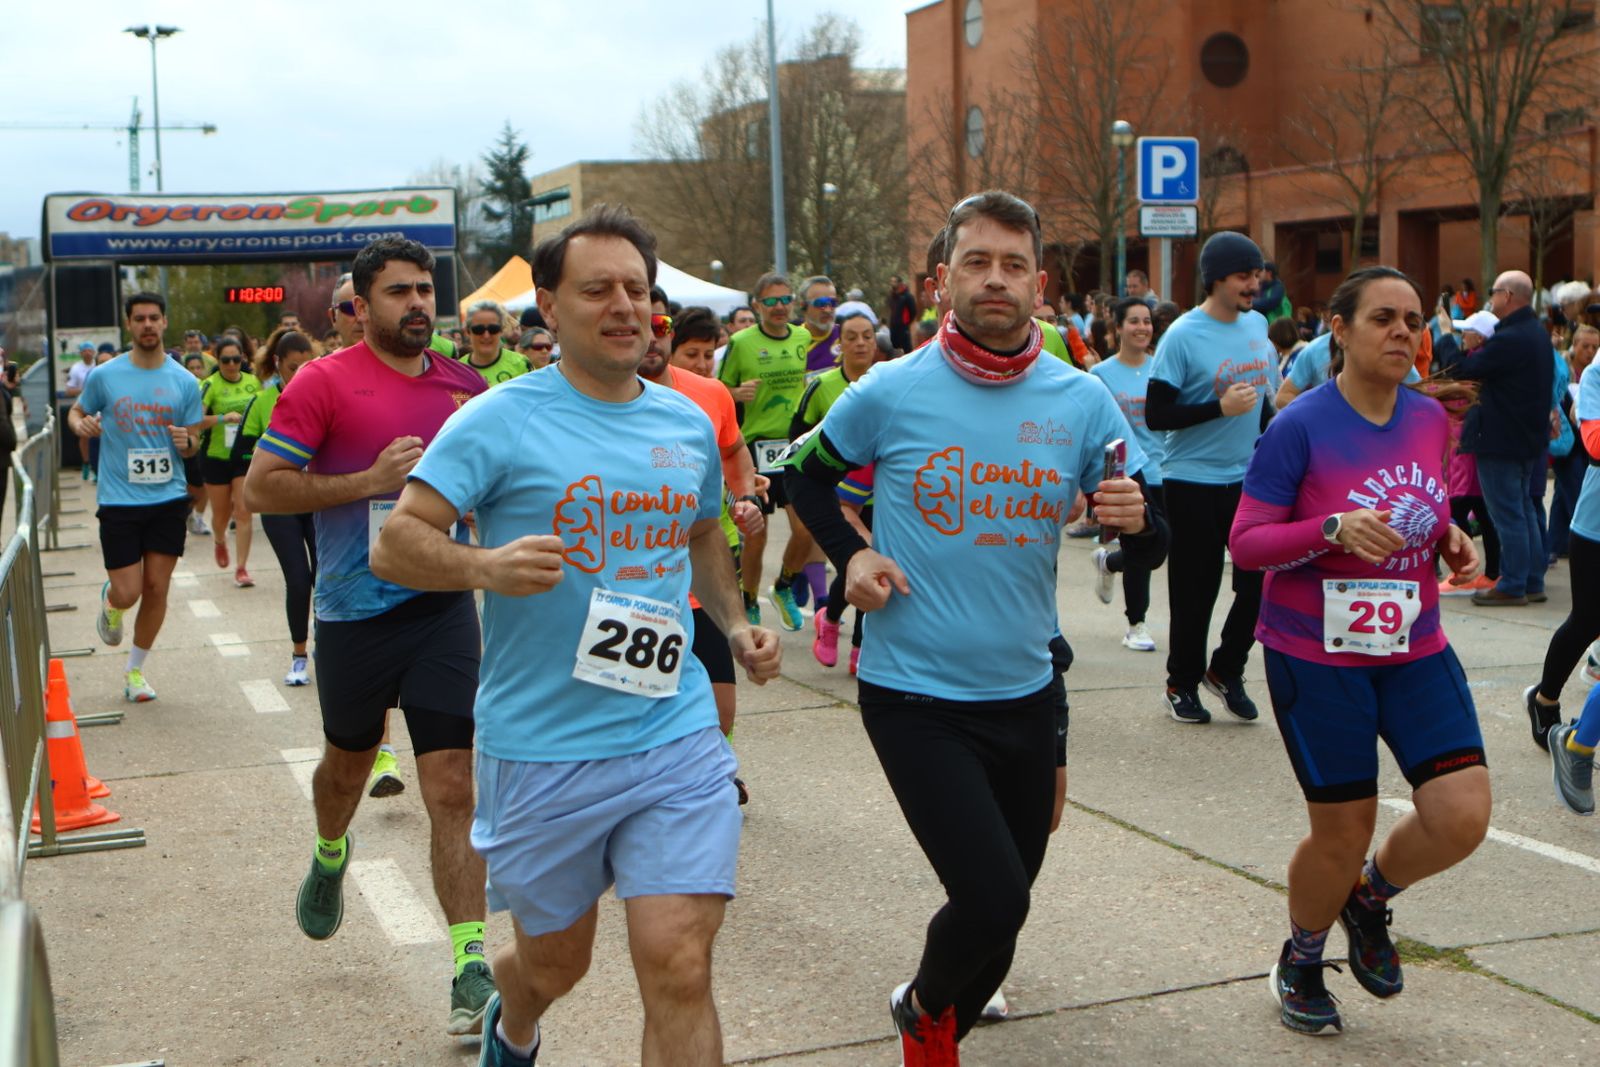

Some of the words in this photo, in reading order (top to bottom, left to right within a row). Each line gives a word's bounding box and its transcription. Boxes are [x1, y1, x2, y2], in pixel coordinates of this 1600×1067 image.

[1151, 145, 1187, 195] P
[107, 230, 404, 250] www.orycronsport.com
[229, 287, 283, 303] 11:02:00
[133, 459, 170, 473] 313
[971, 459, 1061, 487] contra
[611, 484, 697, 515] contra
[1347, 461, 1446, 510] Apaches
[970, 494, 999, 519] el
[1005, 492, 1063, 523] ictus
[610, 523, 638, 551] el
[1348, 600, 1403, 635] 29
[589, 619, 682, 674] 286
